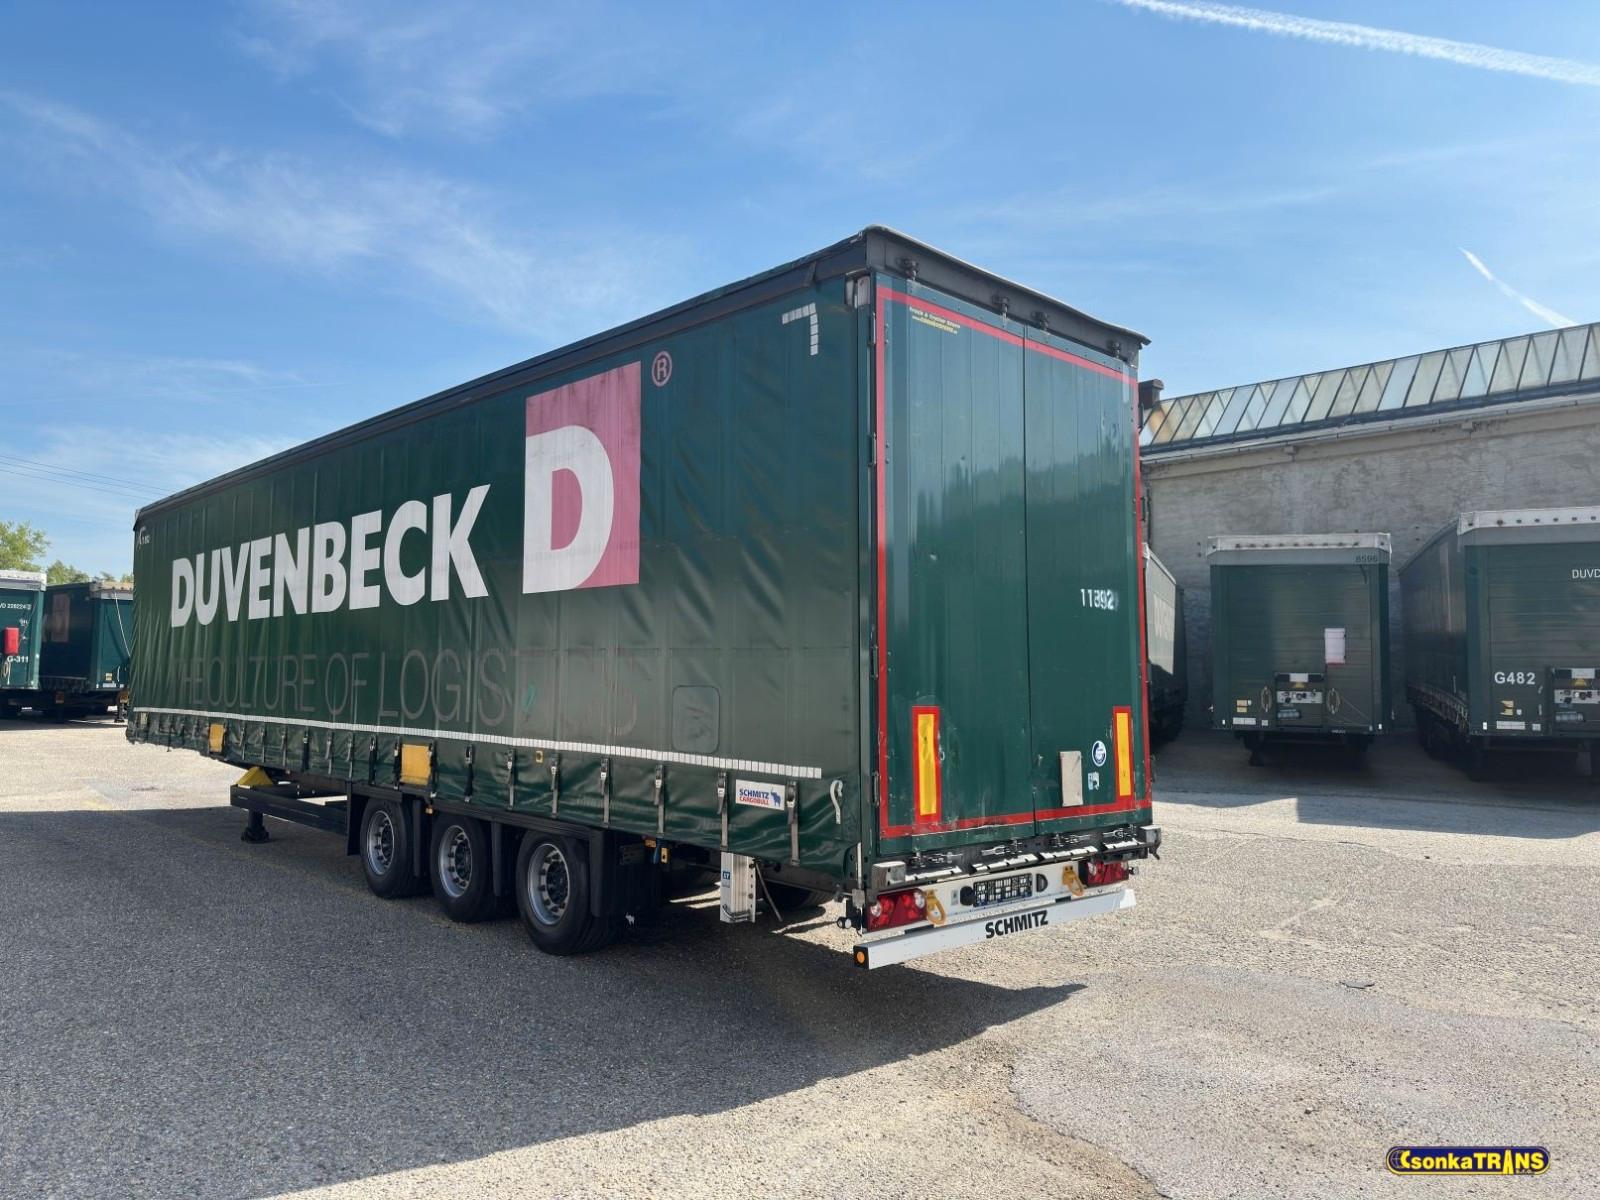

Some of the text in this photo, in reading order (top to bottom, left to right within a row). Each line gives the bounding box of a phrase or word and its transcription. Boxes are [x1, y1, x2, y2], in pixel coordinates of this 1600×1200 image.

[171, 484, 491, 628] DUVENBECK
[523, 425, 614, 594] D
[1494, 671, 1536, 685] G482
[739, 789, 770, 799] SCHMITZ
[985, 910, 1049, 939] SCHMITZ
